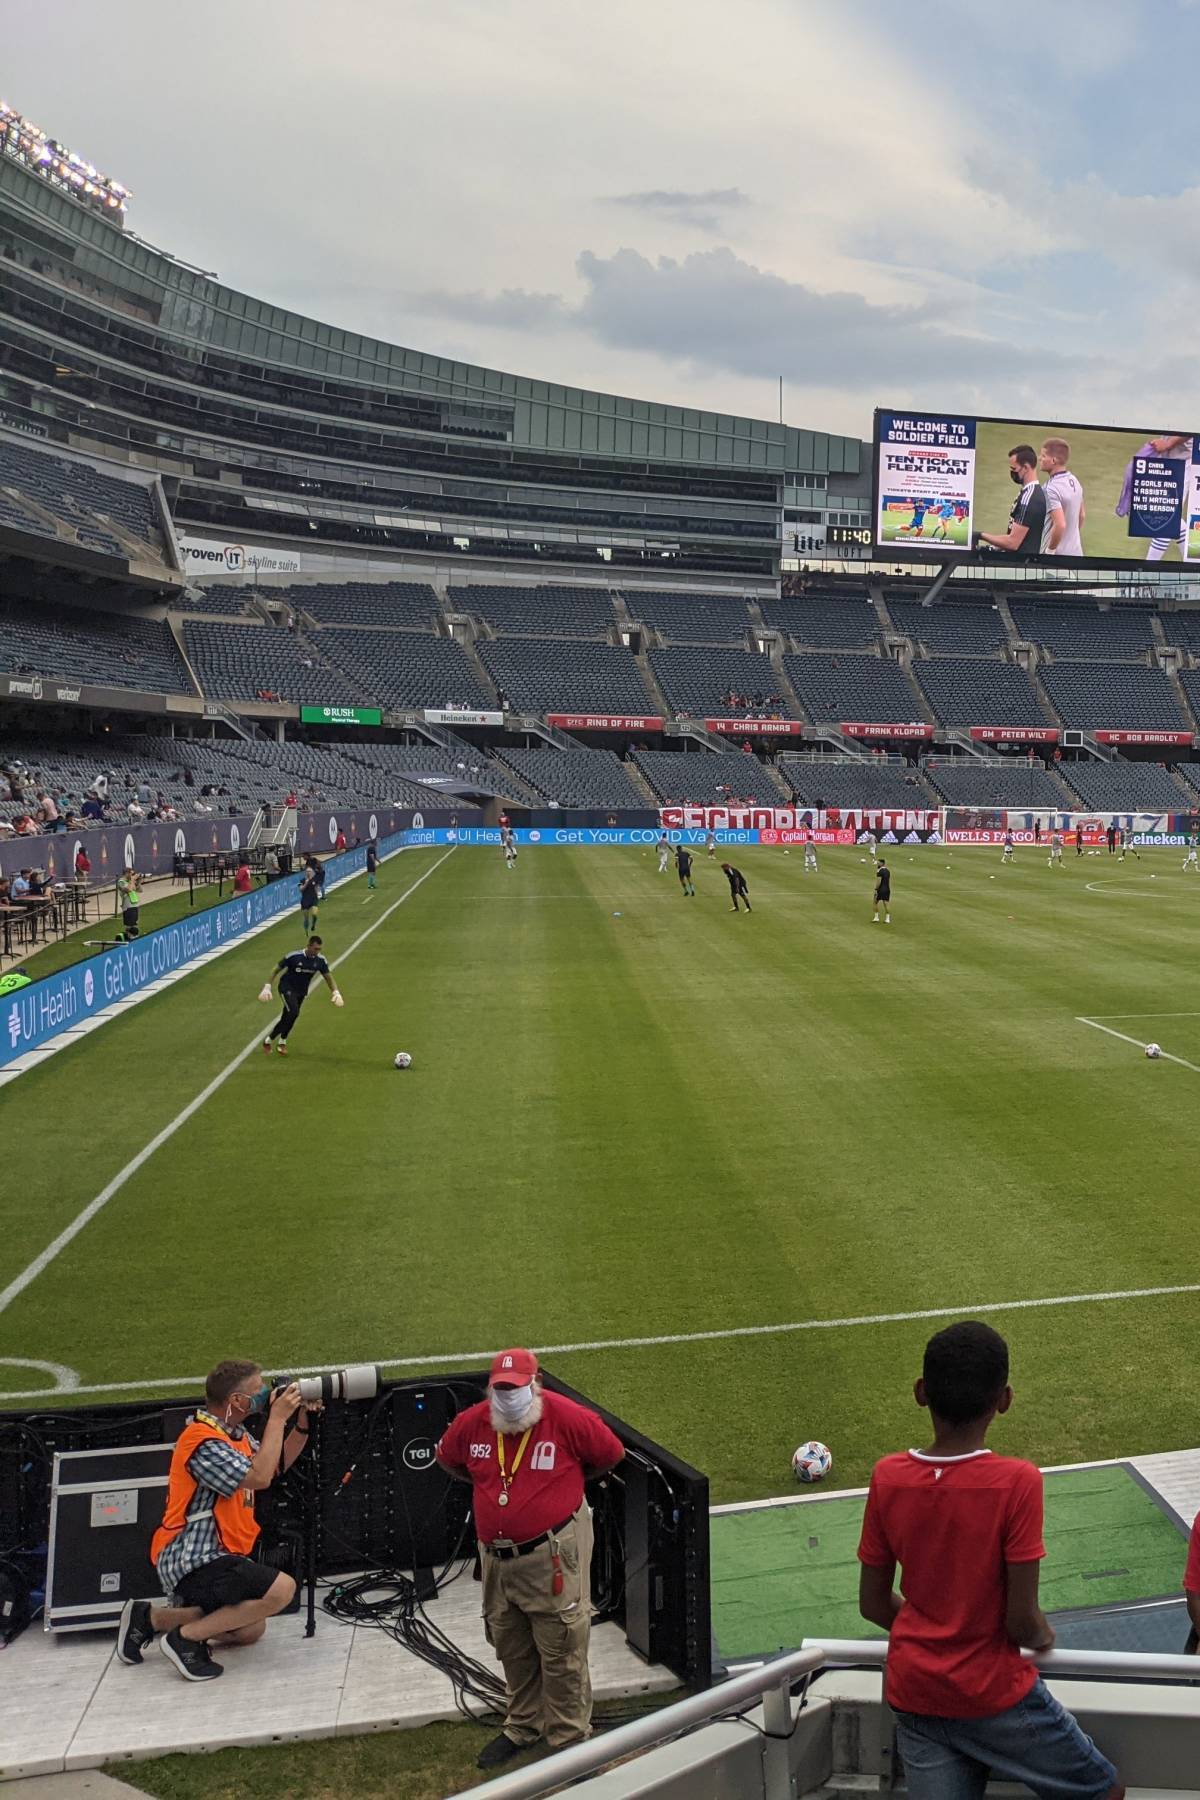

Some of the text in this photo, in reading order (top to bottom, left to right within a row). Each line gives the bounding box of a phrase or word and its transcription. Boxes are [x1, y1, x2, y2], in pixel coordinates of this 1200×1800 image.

[893, 419, 965, 434] WELCOME TO
[888, 431, 969, 445] SOLDIER FIELD
[886, 455, 969, 467] TEN TICKET
[1136, 459, 1146, 474] 9
[888, 463, 967, 475] FLEX PLAN
[1140, 480, 1161, 488] GOALS
[1140, 488, 1168, 496] ASSISTS
[1149, 497, 1179, 505] MATCHES
[833, 529, 871, 544] 11:40
[793, 534, 825, 553] Lite
[838, 546, 863, 558] LOFT
[248, 555, 277, 569] skyline
[278, 559, 298, 572] suite
[331, 708, 354, 717] RUSH
[440, 714, 477, 722] Heineken
[587, 719, 608, 727] RING
[625, 720, 644, 728] FIRE
[733, 723, 758, 731] CHRIS
[761, 724, 791, 732] ARMAS
[864, 727, 891, 735] FRANK
[894, 728, 925, 736] KLOPAS
[1144, 734, 1178, 742] BRADLEY
[458, 830, 518, 841] UI Heah
[555, 830, 750, 843] Get Your COVID Vacine!
[781, 830, 806, 842] Captain
[948, 831, 990, 841] WELLS
[994, 831, 1034, 842] FARGO
[1131, 833, 1185, 844] eineken
[104, 914, 212, 999] Get Your COVID Vaccine!
[22, 976, 77, 1040] UI Health
[409, 1449, 430, 1460] TGI
